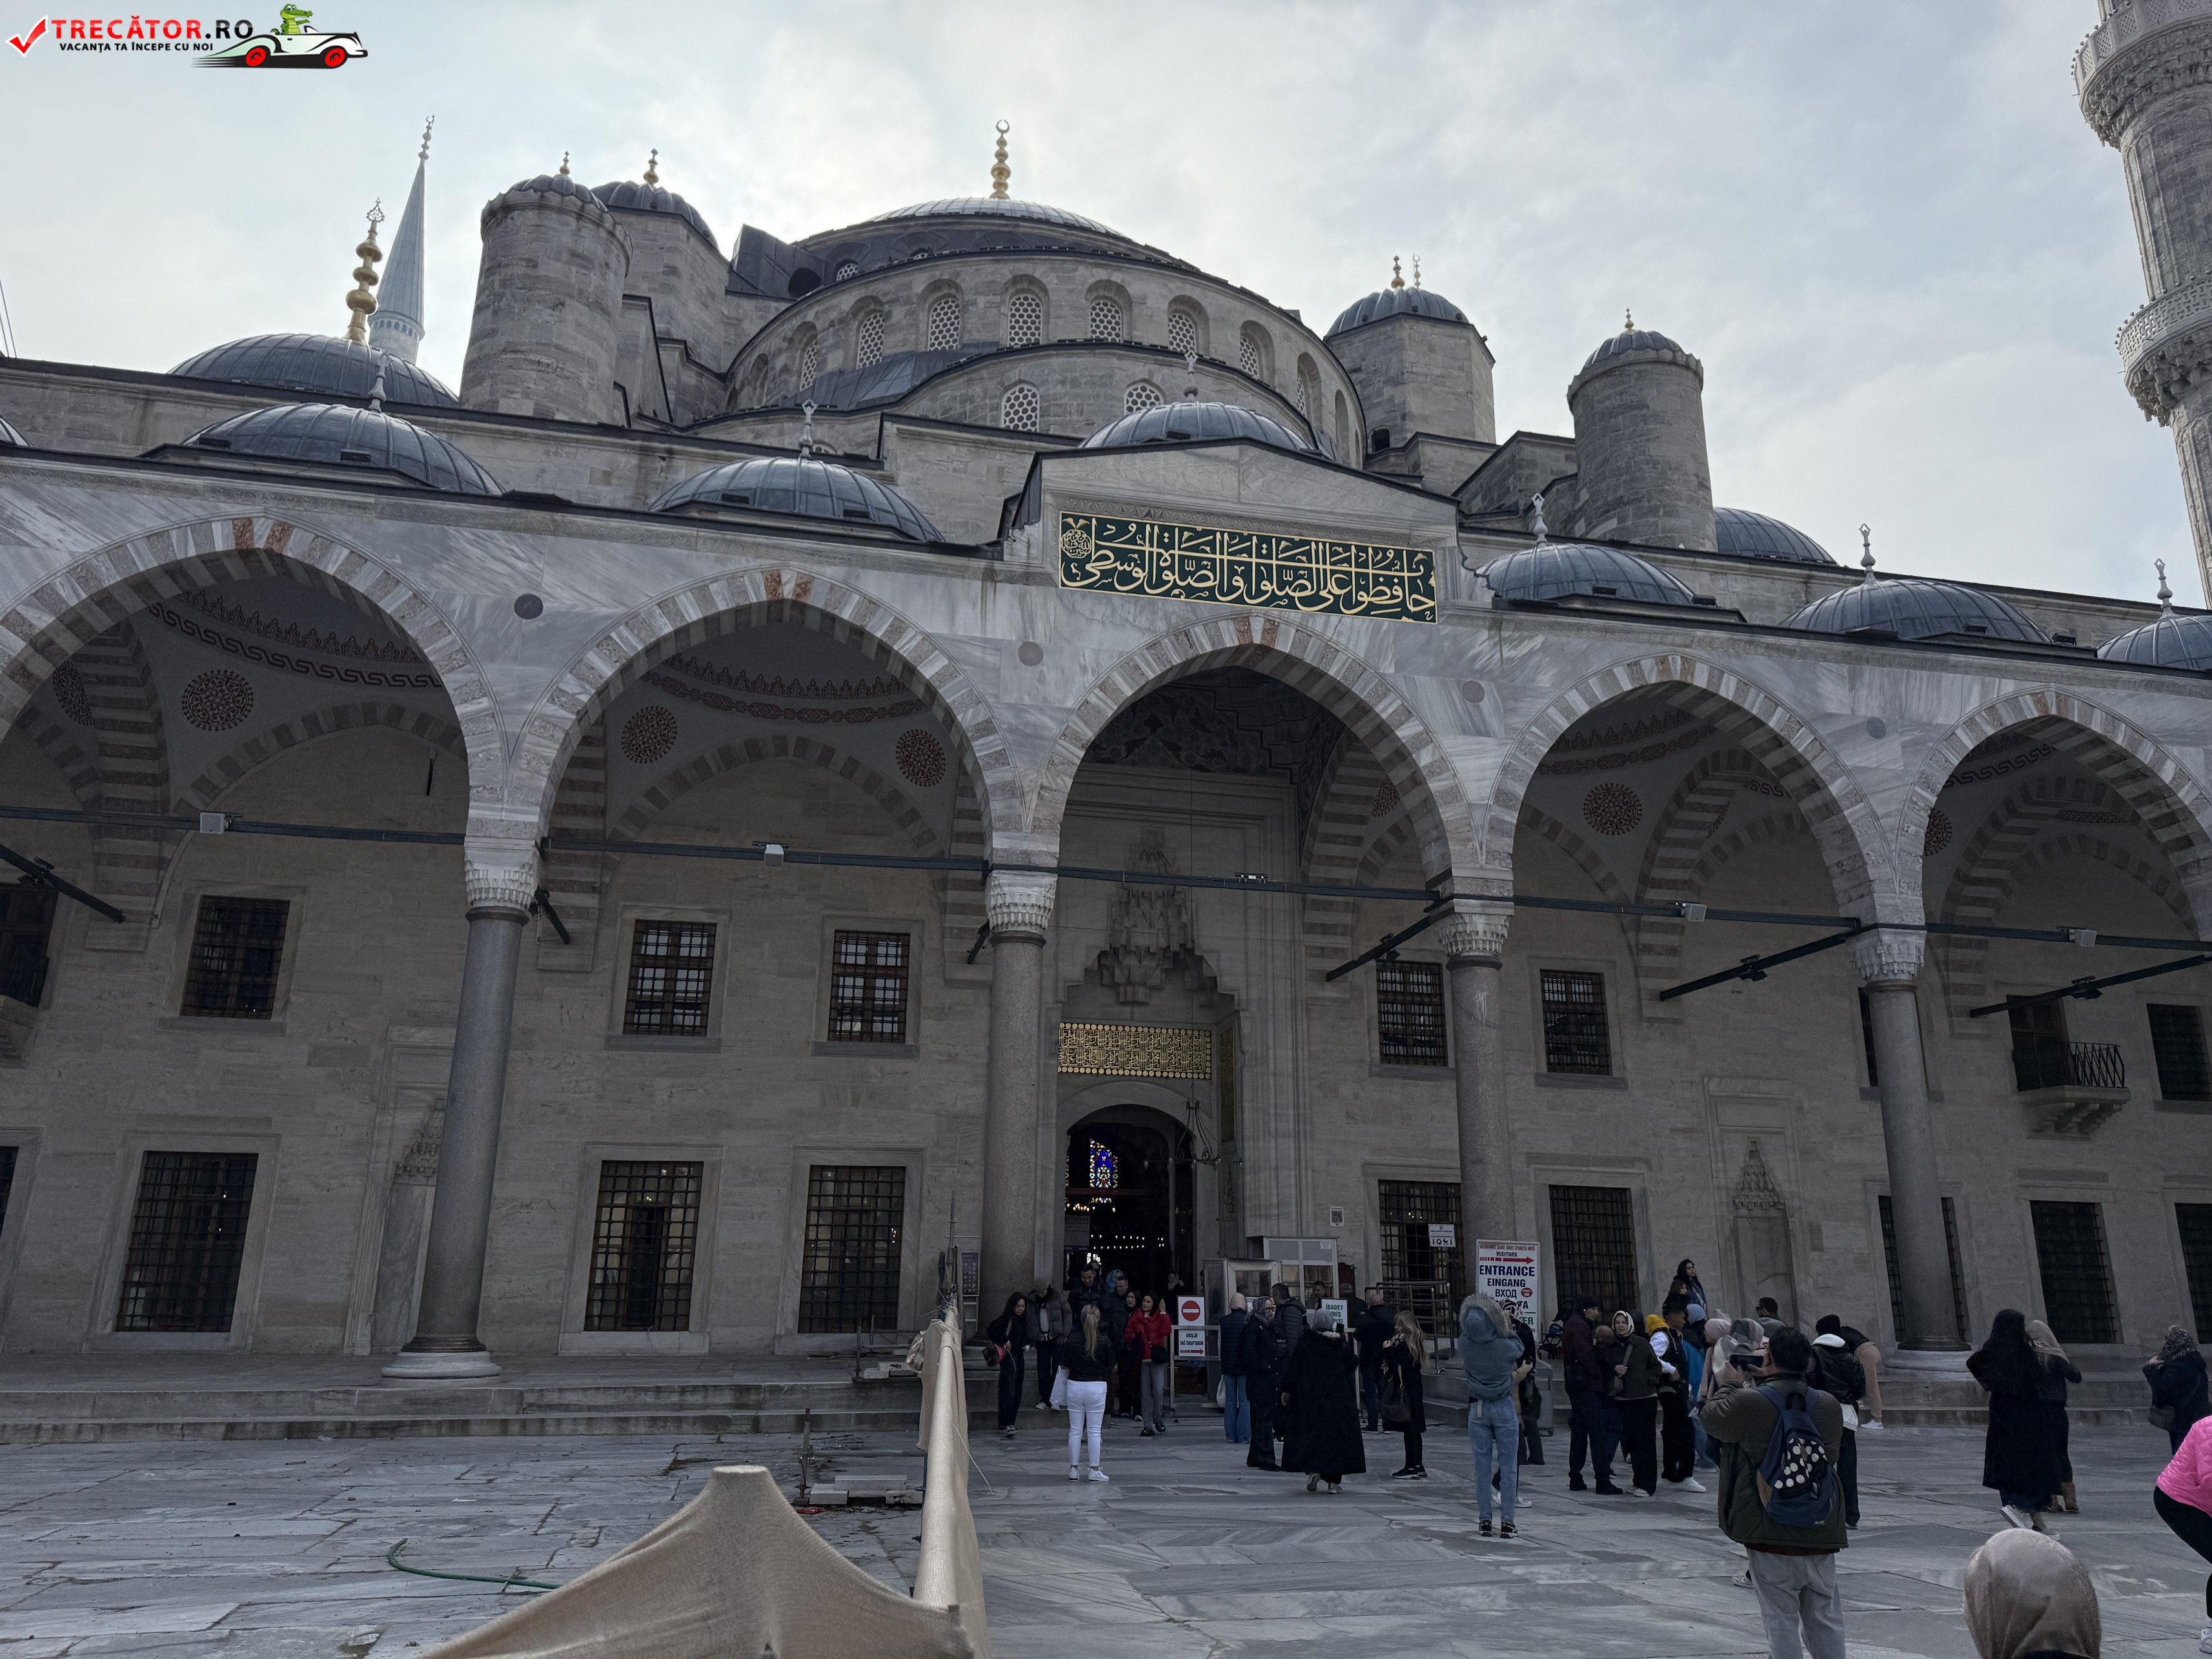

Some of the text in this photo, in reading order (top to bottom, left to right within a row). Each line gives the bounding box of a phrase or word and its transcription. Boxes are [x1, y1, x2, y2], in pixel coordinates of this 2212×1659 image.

[1479, 1265, 1536, 1276] ENTRANCE
[1487, 1278, 1526, 1287] EINGANG
[1495, 1289, 1517, 1299] ВХОД
